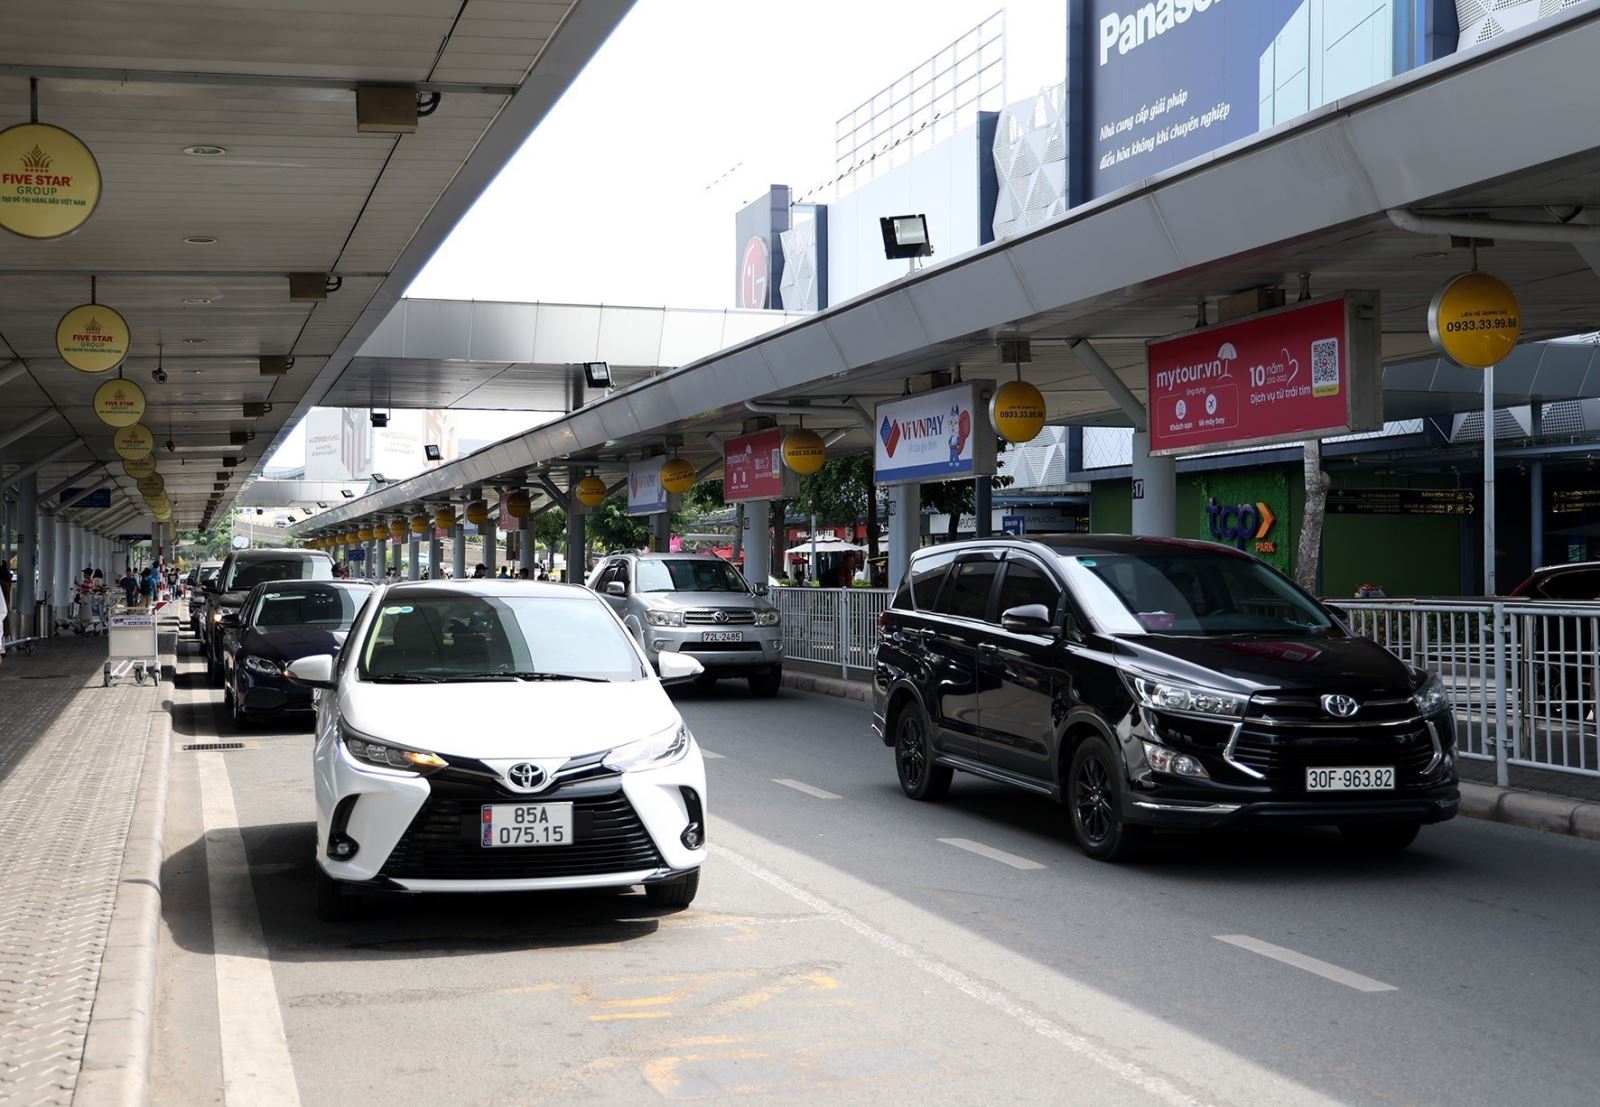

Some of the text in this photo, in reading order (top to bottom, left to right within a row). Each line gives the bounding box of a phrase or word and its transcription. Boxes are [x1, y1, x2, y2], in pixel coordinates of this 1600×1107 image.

[1100, 0, 1222, 66] Panas
[1100, 89, 1188, 141] Nhà cung cấp giải pháp
[1116, 146, 1130, 163] hòa
[1131, 138, 1155, 156] không
[1156, 127, 1169, 146] khí
[1170, 116, 1199, 139] chuyên
[1200, 102, 1230, 128] nghiệp
[3, 174, 71, 187] FIVE STAR
[16, 186, 57, 196] GROUP
[92, 335, 113, 343] STAR
[1156, 359, 1222, 392] mytour.vn
[1249, 362, 1284, 388] 10 năm
[1250, 393, 1266, 406] Dịch
[1266, 392, 1276, 403] vụ
[1285, 385, 1298, 398] trái
[912, 415, 945, 439] VNPAY
[1215, 416, 1226, 425] bay
[1208, 497, 1256, 550] tcp
[1256, 543, 1273, 552] PARK
[1309, 769, 1392, 788] 30F-963.82
[514, 806, 549, 824] 85A
[500, 825, 564, 844] 075.15
